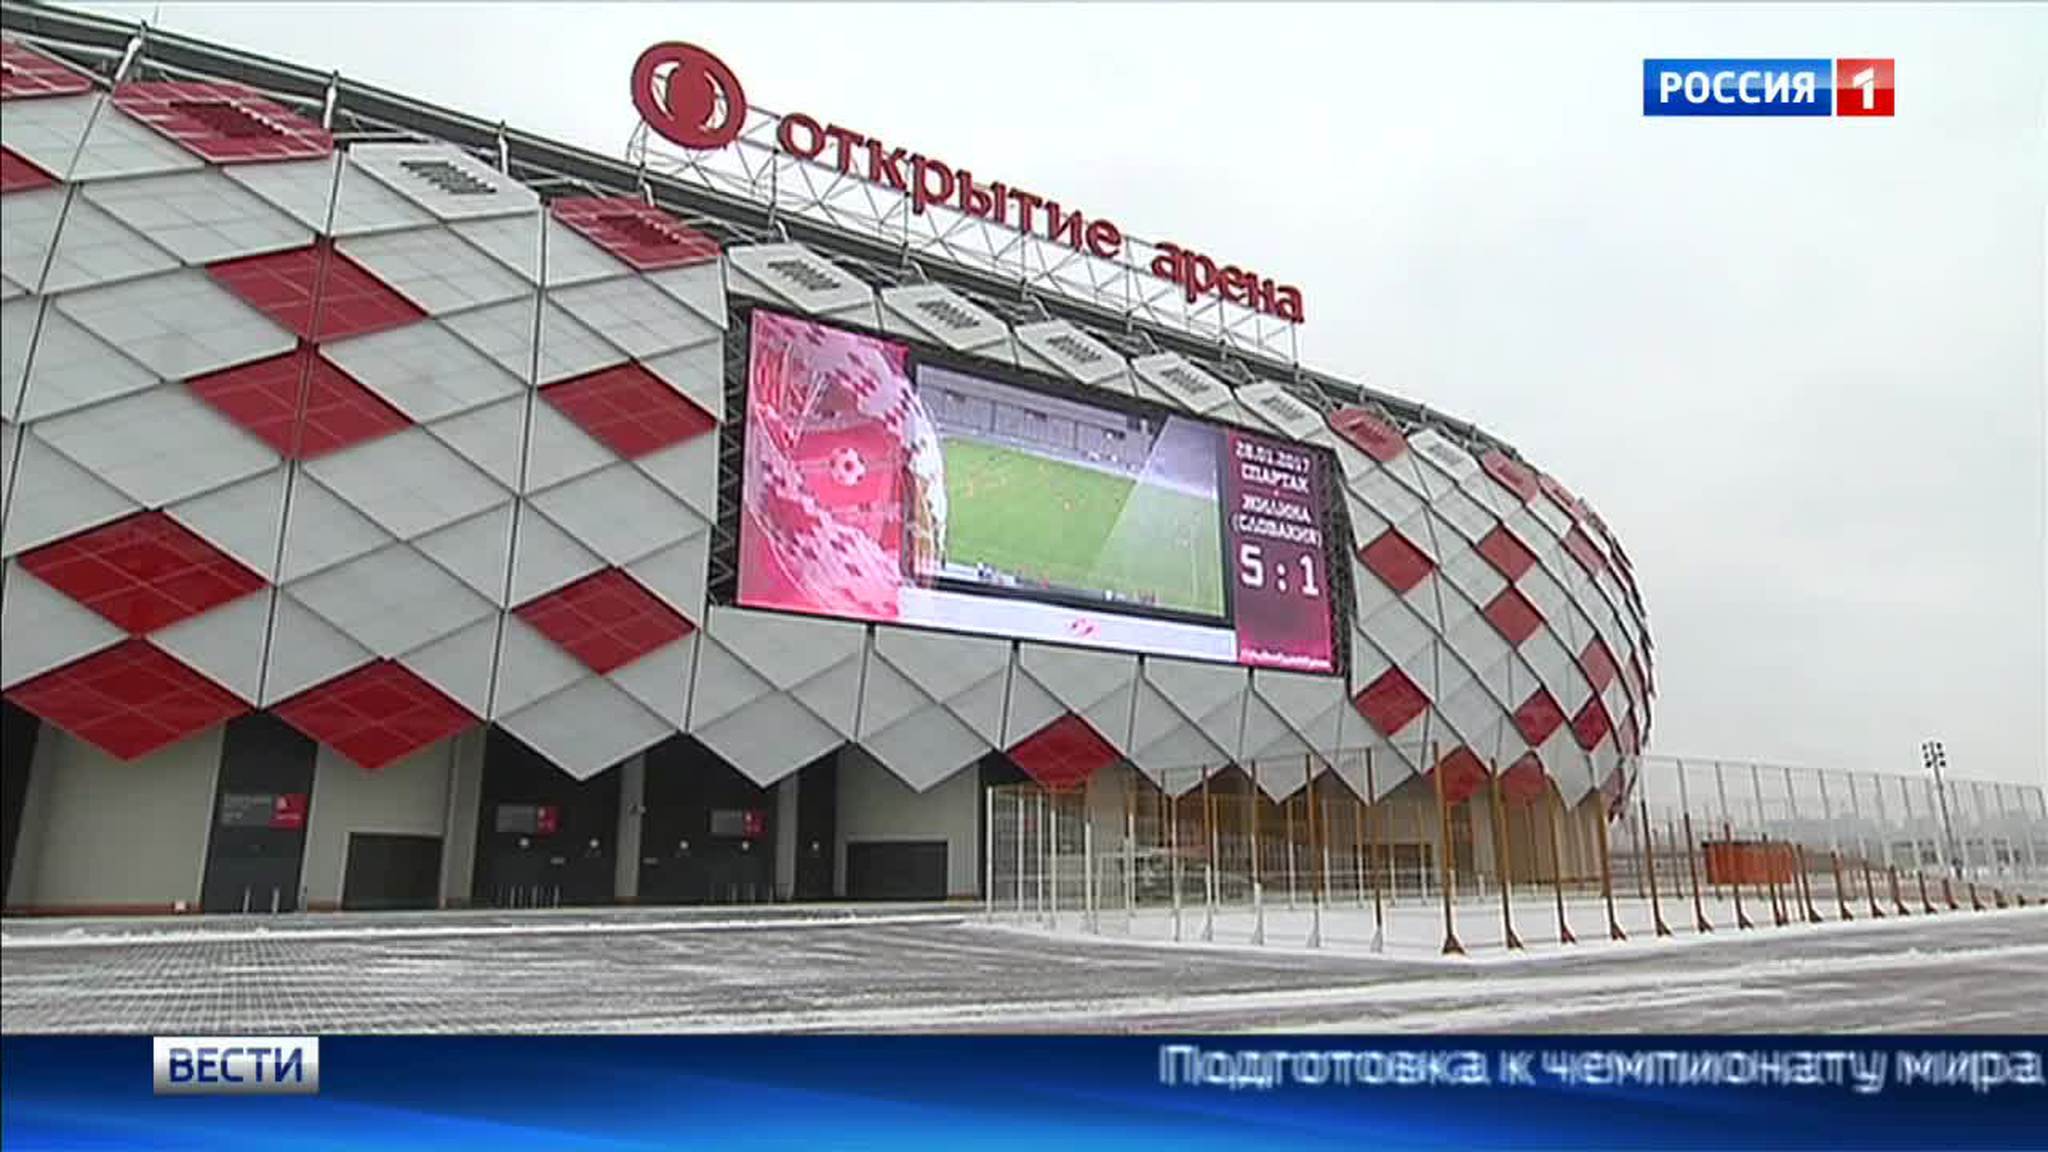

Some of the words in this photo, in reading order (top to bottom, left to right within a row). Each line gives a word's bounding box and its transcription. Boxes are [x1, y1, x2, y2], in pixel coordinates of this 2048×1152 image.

[775, 110, 1124, 261] открытие
[1149, 240, 1306, 324] арена
[1240, 465, 1310, 494] СПАРТАК
[1239, 544, 1265, 588] 5
[1299, 553, 1320, 597] 1
